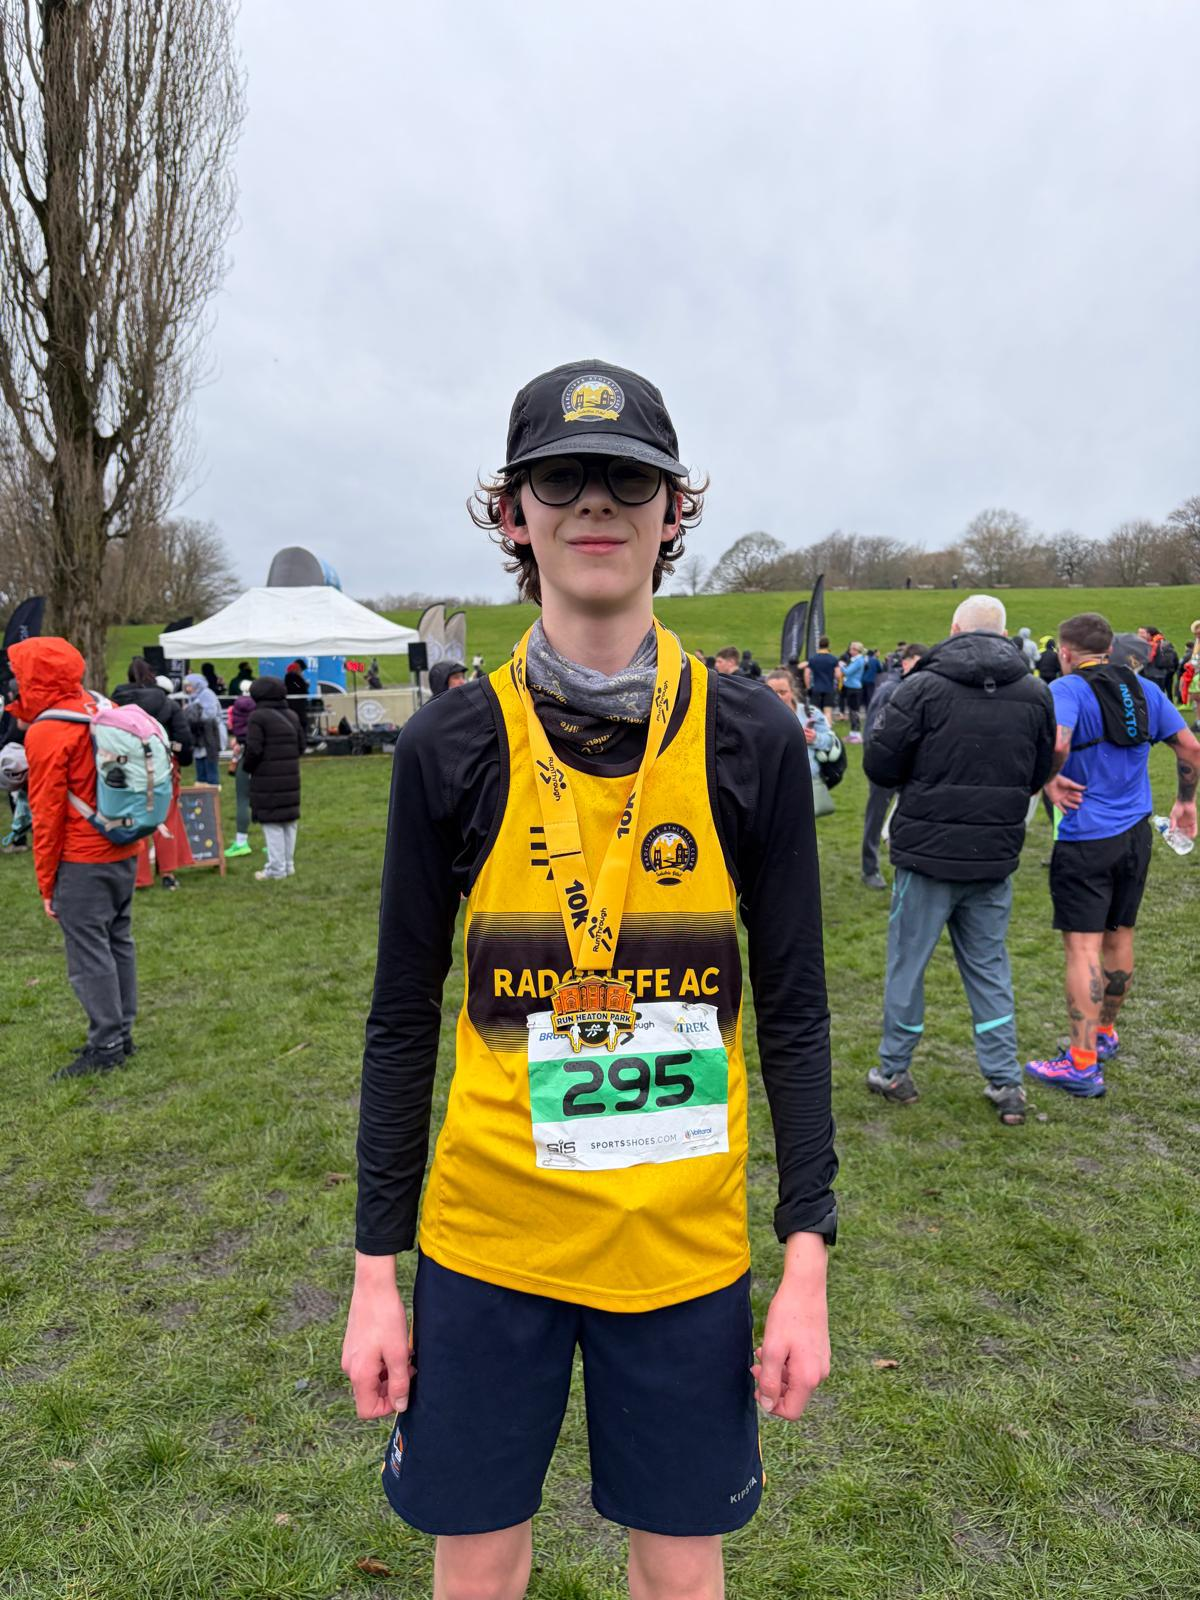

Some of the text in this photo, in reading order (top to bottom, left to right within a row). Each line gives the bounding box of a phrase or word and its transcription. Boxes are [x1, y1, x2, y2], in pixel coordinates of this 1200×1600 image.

[1119, 683, 1137, 737] INOXTO
[548, 756, 562, 802] RunThrough
[565, 879, 590, 930] 10K
[592, 907, 608, 953] RunThrough
[493, 967, 720, 998] RADFFE AC
[556, 1012, 632, 1025] RUN HEATON PARK
[677, 1021, 710, 1033] TREK
[562, 1053, 694, 1116] 295
[590, 1133, 677, 1150] SPORTSSHOES.COM
[730, 1476, 758, 1504] KIPSTA
